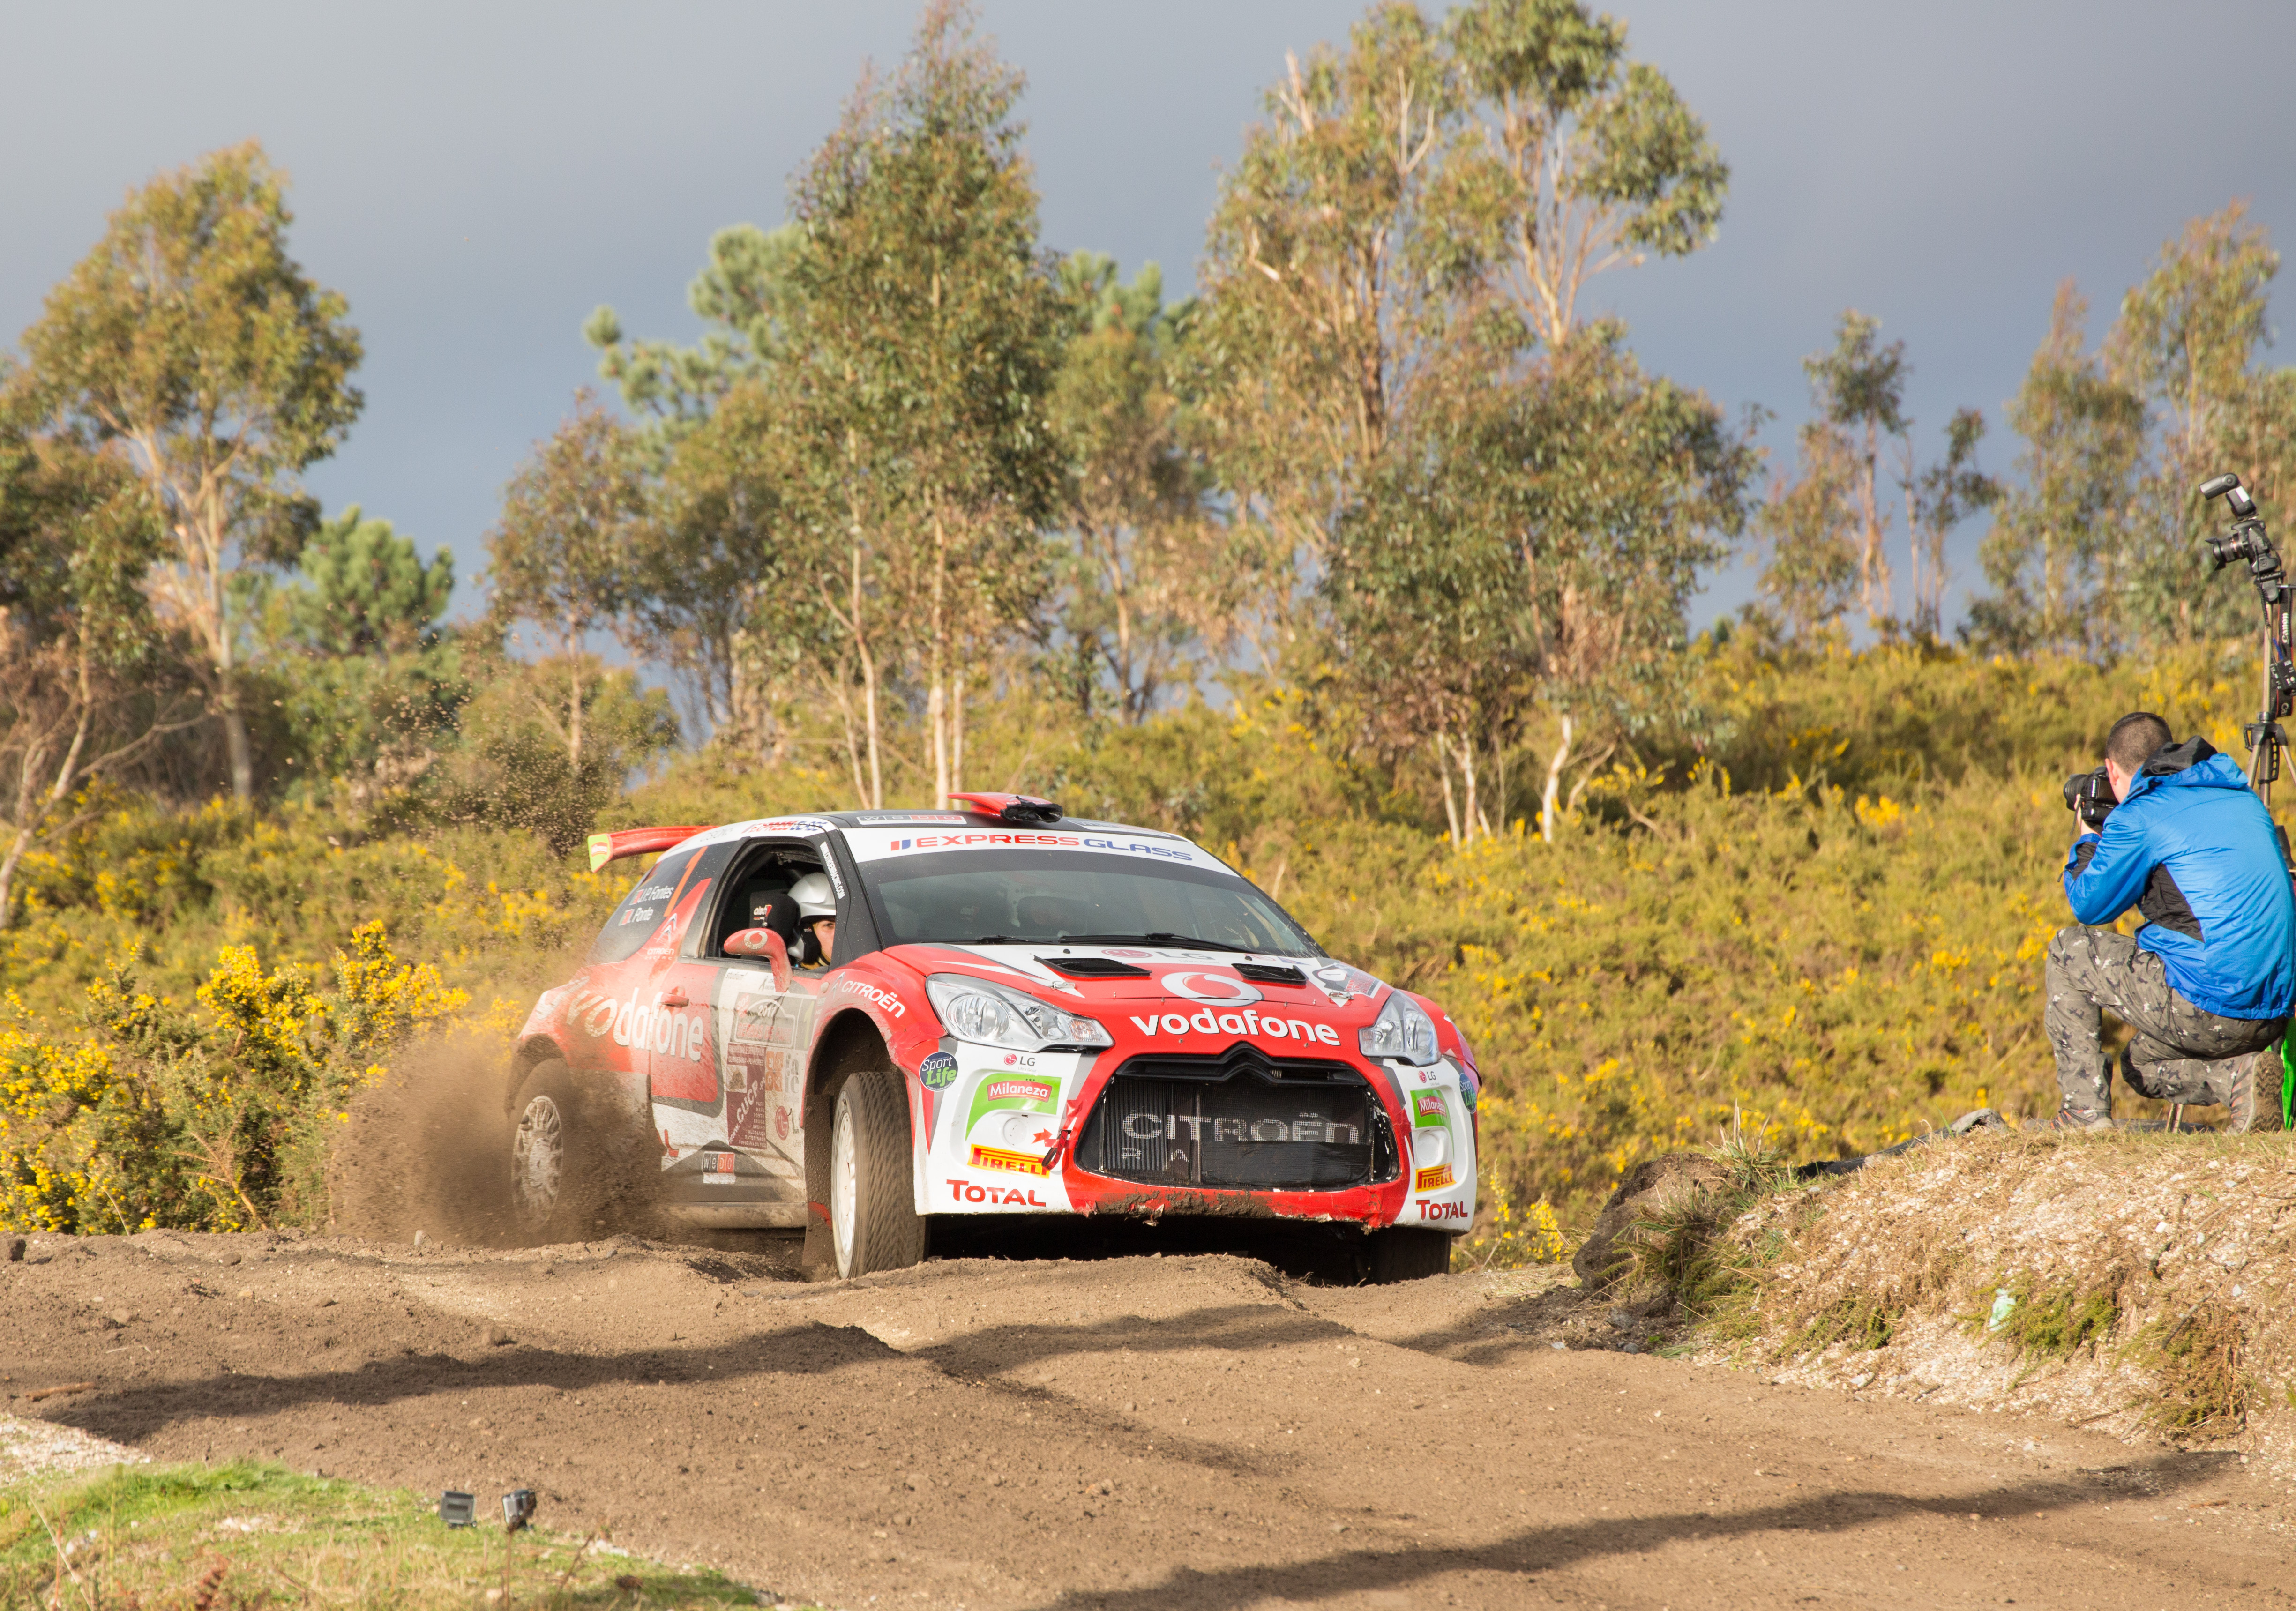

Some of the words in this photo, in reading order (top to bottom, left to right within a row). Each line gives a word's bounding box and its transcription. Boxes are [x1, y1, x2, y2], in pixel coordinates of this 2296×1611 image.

[648, 885, 674, 901] Fontes
[631, 907, 654, 923] Ponte
[1154, 951, 1215, 960] LG
[758, 1004, 778, 1017] 2017
[566, 987, 703, 1062] vodafone
[1130, 1008, 1341, 1046] vodafone
[922, 1056, 953, 1072] Sport
[1019, 1056, 1036, 1066] LG
[926, 1067, 957, 1087] Life
[1427, 1071, 1436, 1081] LG
[990, 1082, 1048, 1098] Milaneza
[1459, 1080, 1473, 1092] Sport
[1420, 1099, 1446, 1112] Milaneza
[972, 1147, 1047, 1176] PIRELLI
[1417, 1165, 1453, 1189] PIRELLI
[947, 1179, 1047, 1207] TOTAL
[1416, 1199, 1468, 1221] TOTAL
